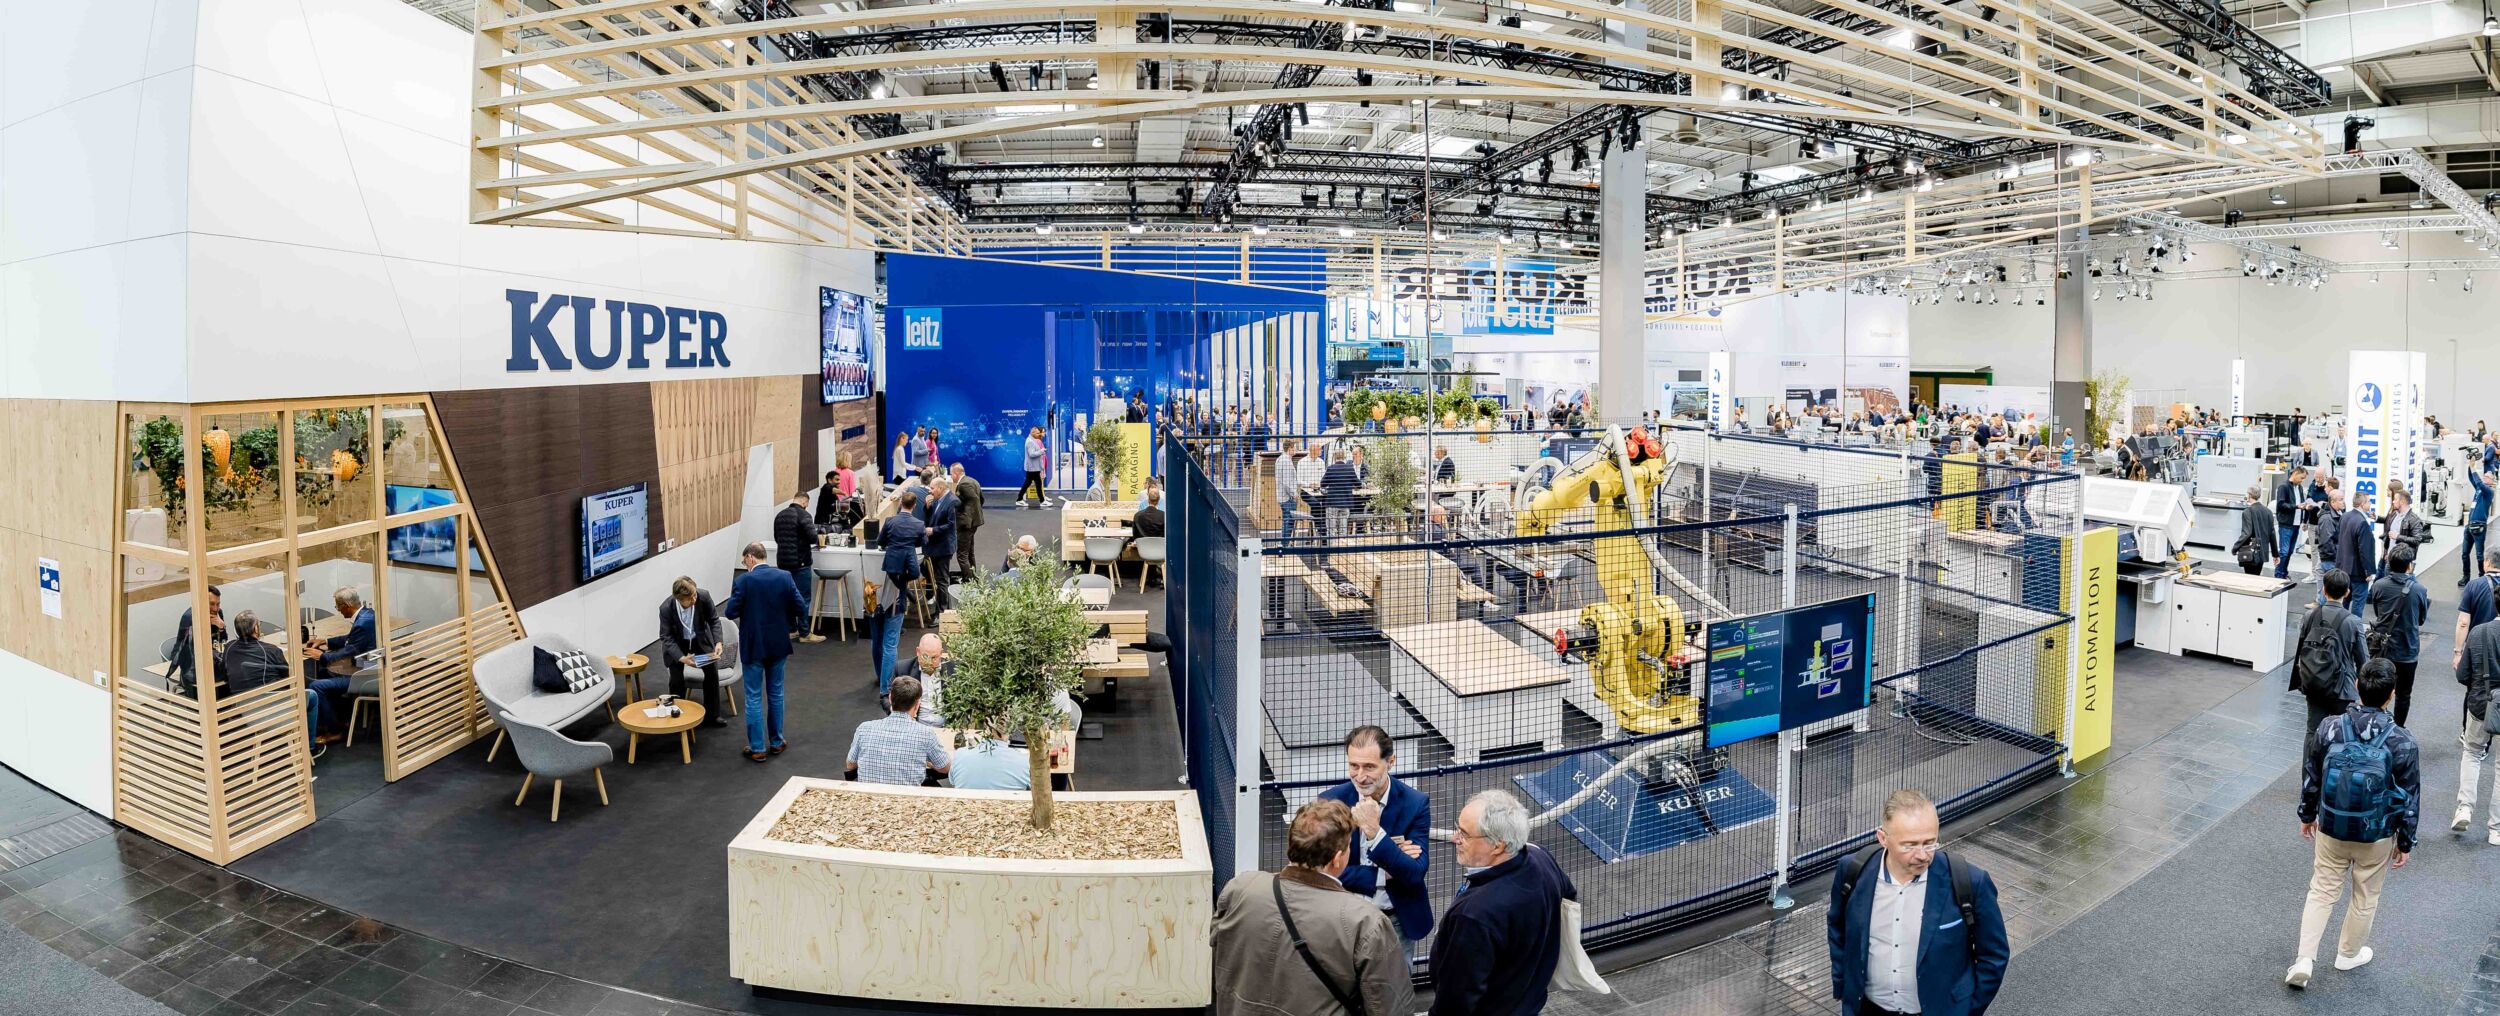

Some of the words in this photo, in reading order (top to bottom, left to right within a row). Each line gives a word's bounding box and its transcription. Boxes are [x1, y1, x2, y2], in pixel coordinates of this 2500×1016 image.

[505, 288, 731, 372] KUPER
[905, 315, 940, 347] leitz
[1130, 442, 1138, 494] PACKAGING
[604, 496, 633, 511] KUPER
[2084, 567, 2100, 711] AUTOMATION
[1572, 769, 1619, 810] KUER
